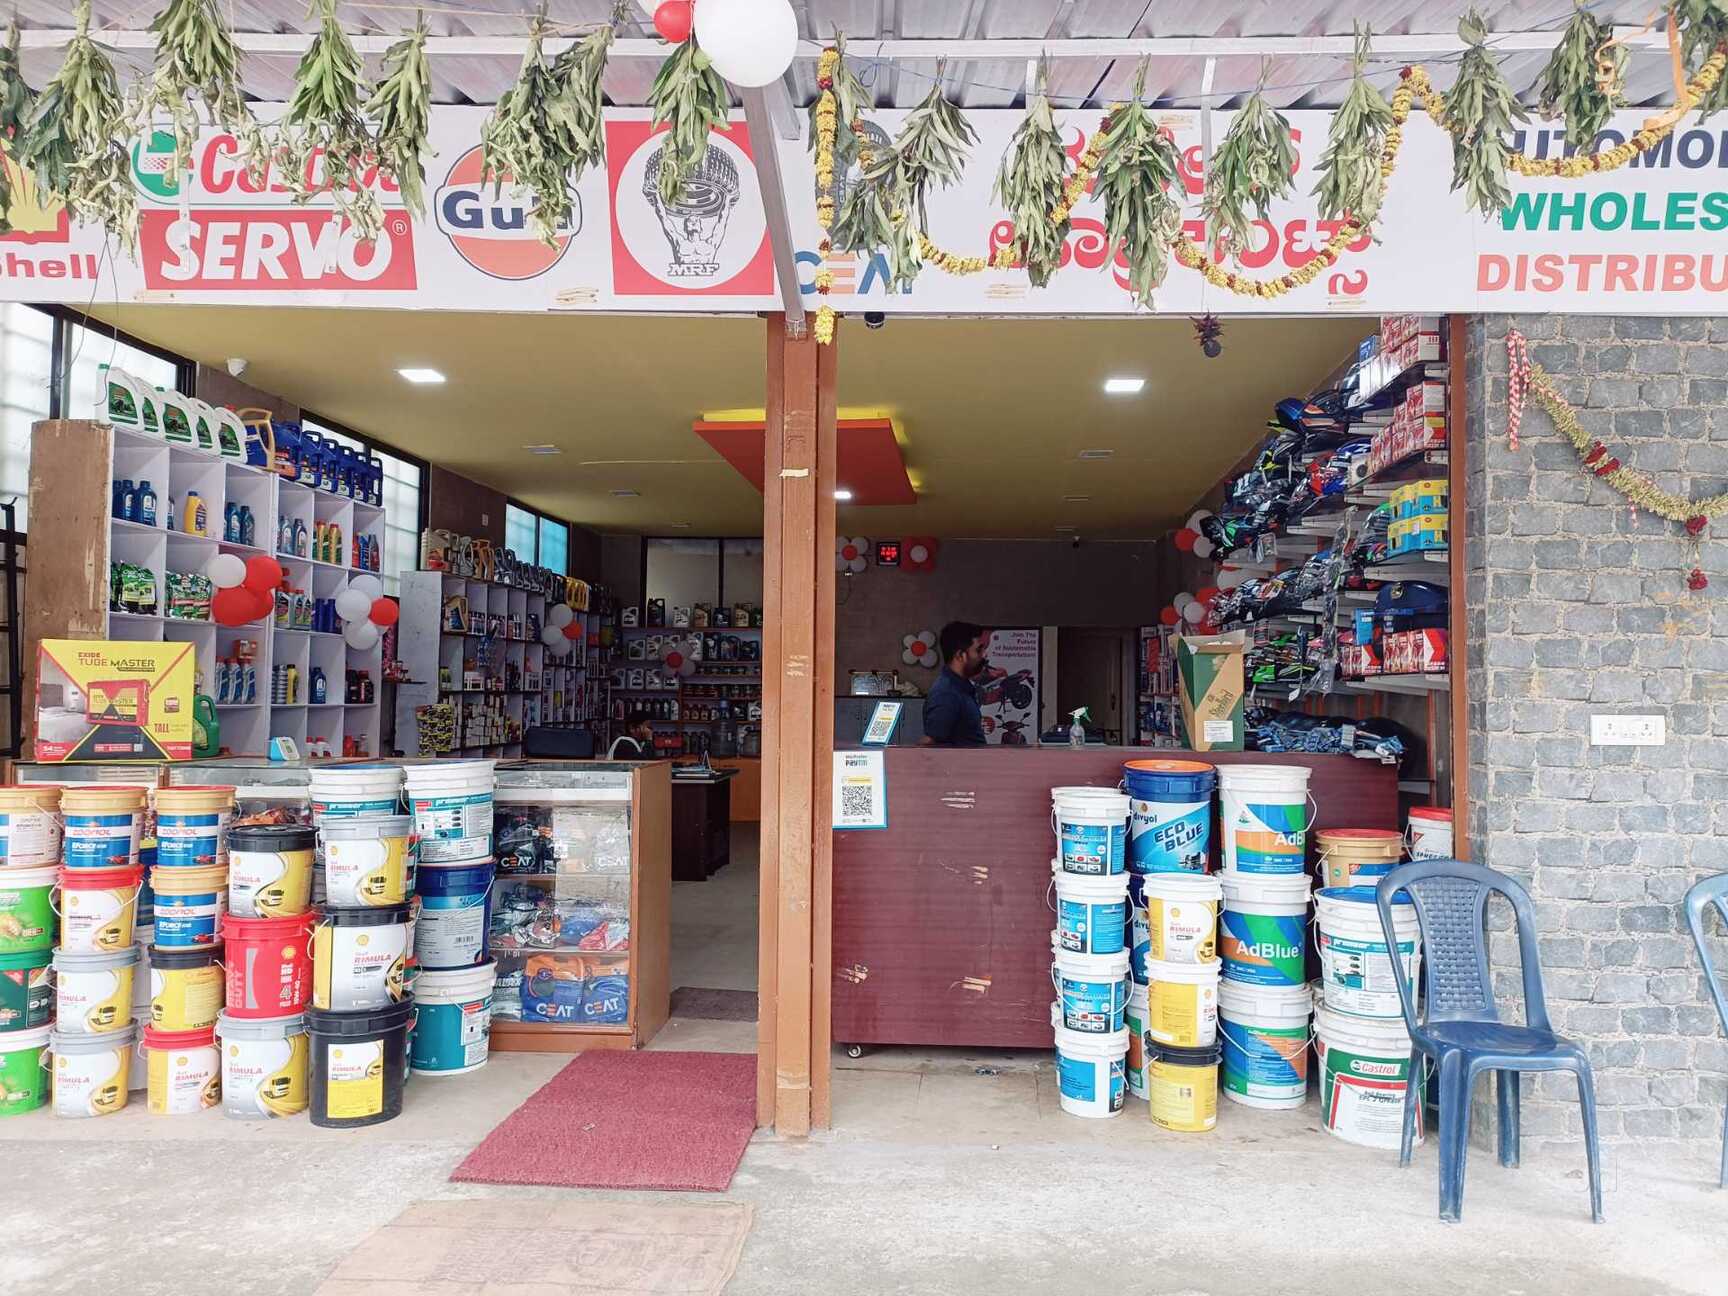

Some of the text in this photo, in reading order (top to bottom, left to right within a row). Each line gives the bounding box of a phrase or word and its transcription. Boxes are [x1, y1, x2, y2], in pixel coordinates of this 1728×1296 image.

[442, 190, 568, 230] Gu
[1501, 192, 1728, 231] WHOLES
[160, 220, 393, 282] SERVO
[0, 253, 97, 280] hell
[666, 262, 720, 278] MRF
[793, 250, 914, 294] CEA
[1476, 254, 1728, 292] DISTRIBU
[78, 658, 156, 667] TUBE MASTER
[1154, 821, 1186, 844] ECO
[1164, 823, 1204, 852] BLUE
[500, 856, 532, 868] CEAT
[1236, 940, 1299, 959] AdBlue
[536, 1003, 576, 1018] CEAT
[584, 997, 620, 1015] CEAT
[1361, 1062, 1397, 1075] Castrol
